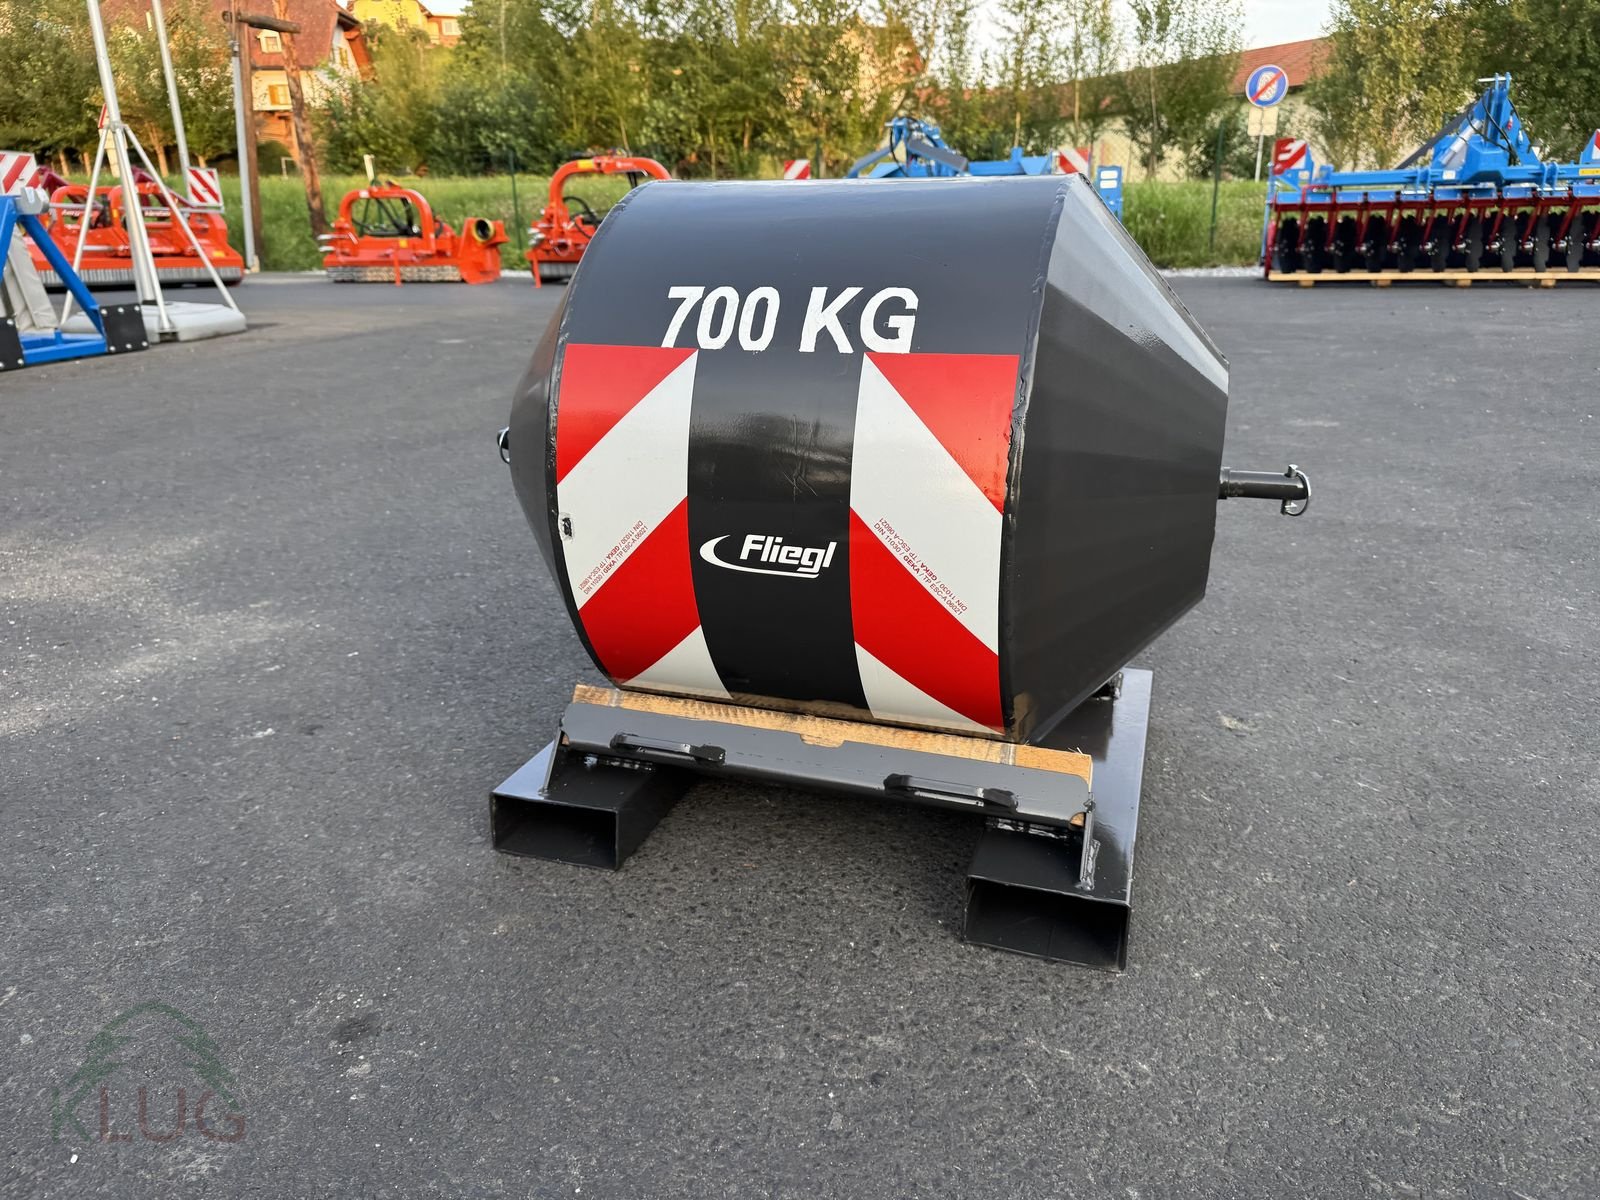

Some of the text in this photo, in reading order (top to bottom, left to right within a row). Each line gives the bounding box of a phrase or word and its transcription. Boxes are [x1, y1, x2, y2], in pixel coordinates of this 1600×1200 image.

[661, 286, 919, 353] 700 KG
[633, 520, 643, 531] DIN
[894, 533, 910, 552] ESC-A
[606, 546, 620, 559] GEKA
[740, 534, 837, 573] Fliegl
[909, 552, 918, 561] TP
[584, 586, 592, 594] DIN
[603, 560, 617, 573] GEKA
[874, 523, 886, 535] DIN
[885, 535, 901, 552] 11030
[903, 555, 920, 574] GEKA
[923, 576, 931, 584] TP
[930, 584, 947, 601] ESC-A
[946, 600, 962, 615] 06021
[920, 563, 937, 580] GEKA
[940, 584, 956, 600] 11030
[956, 600, 967, 611] DIN
